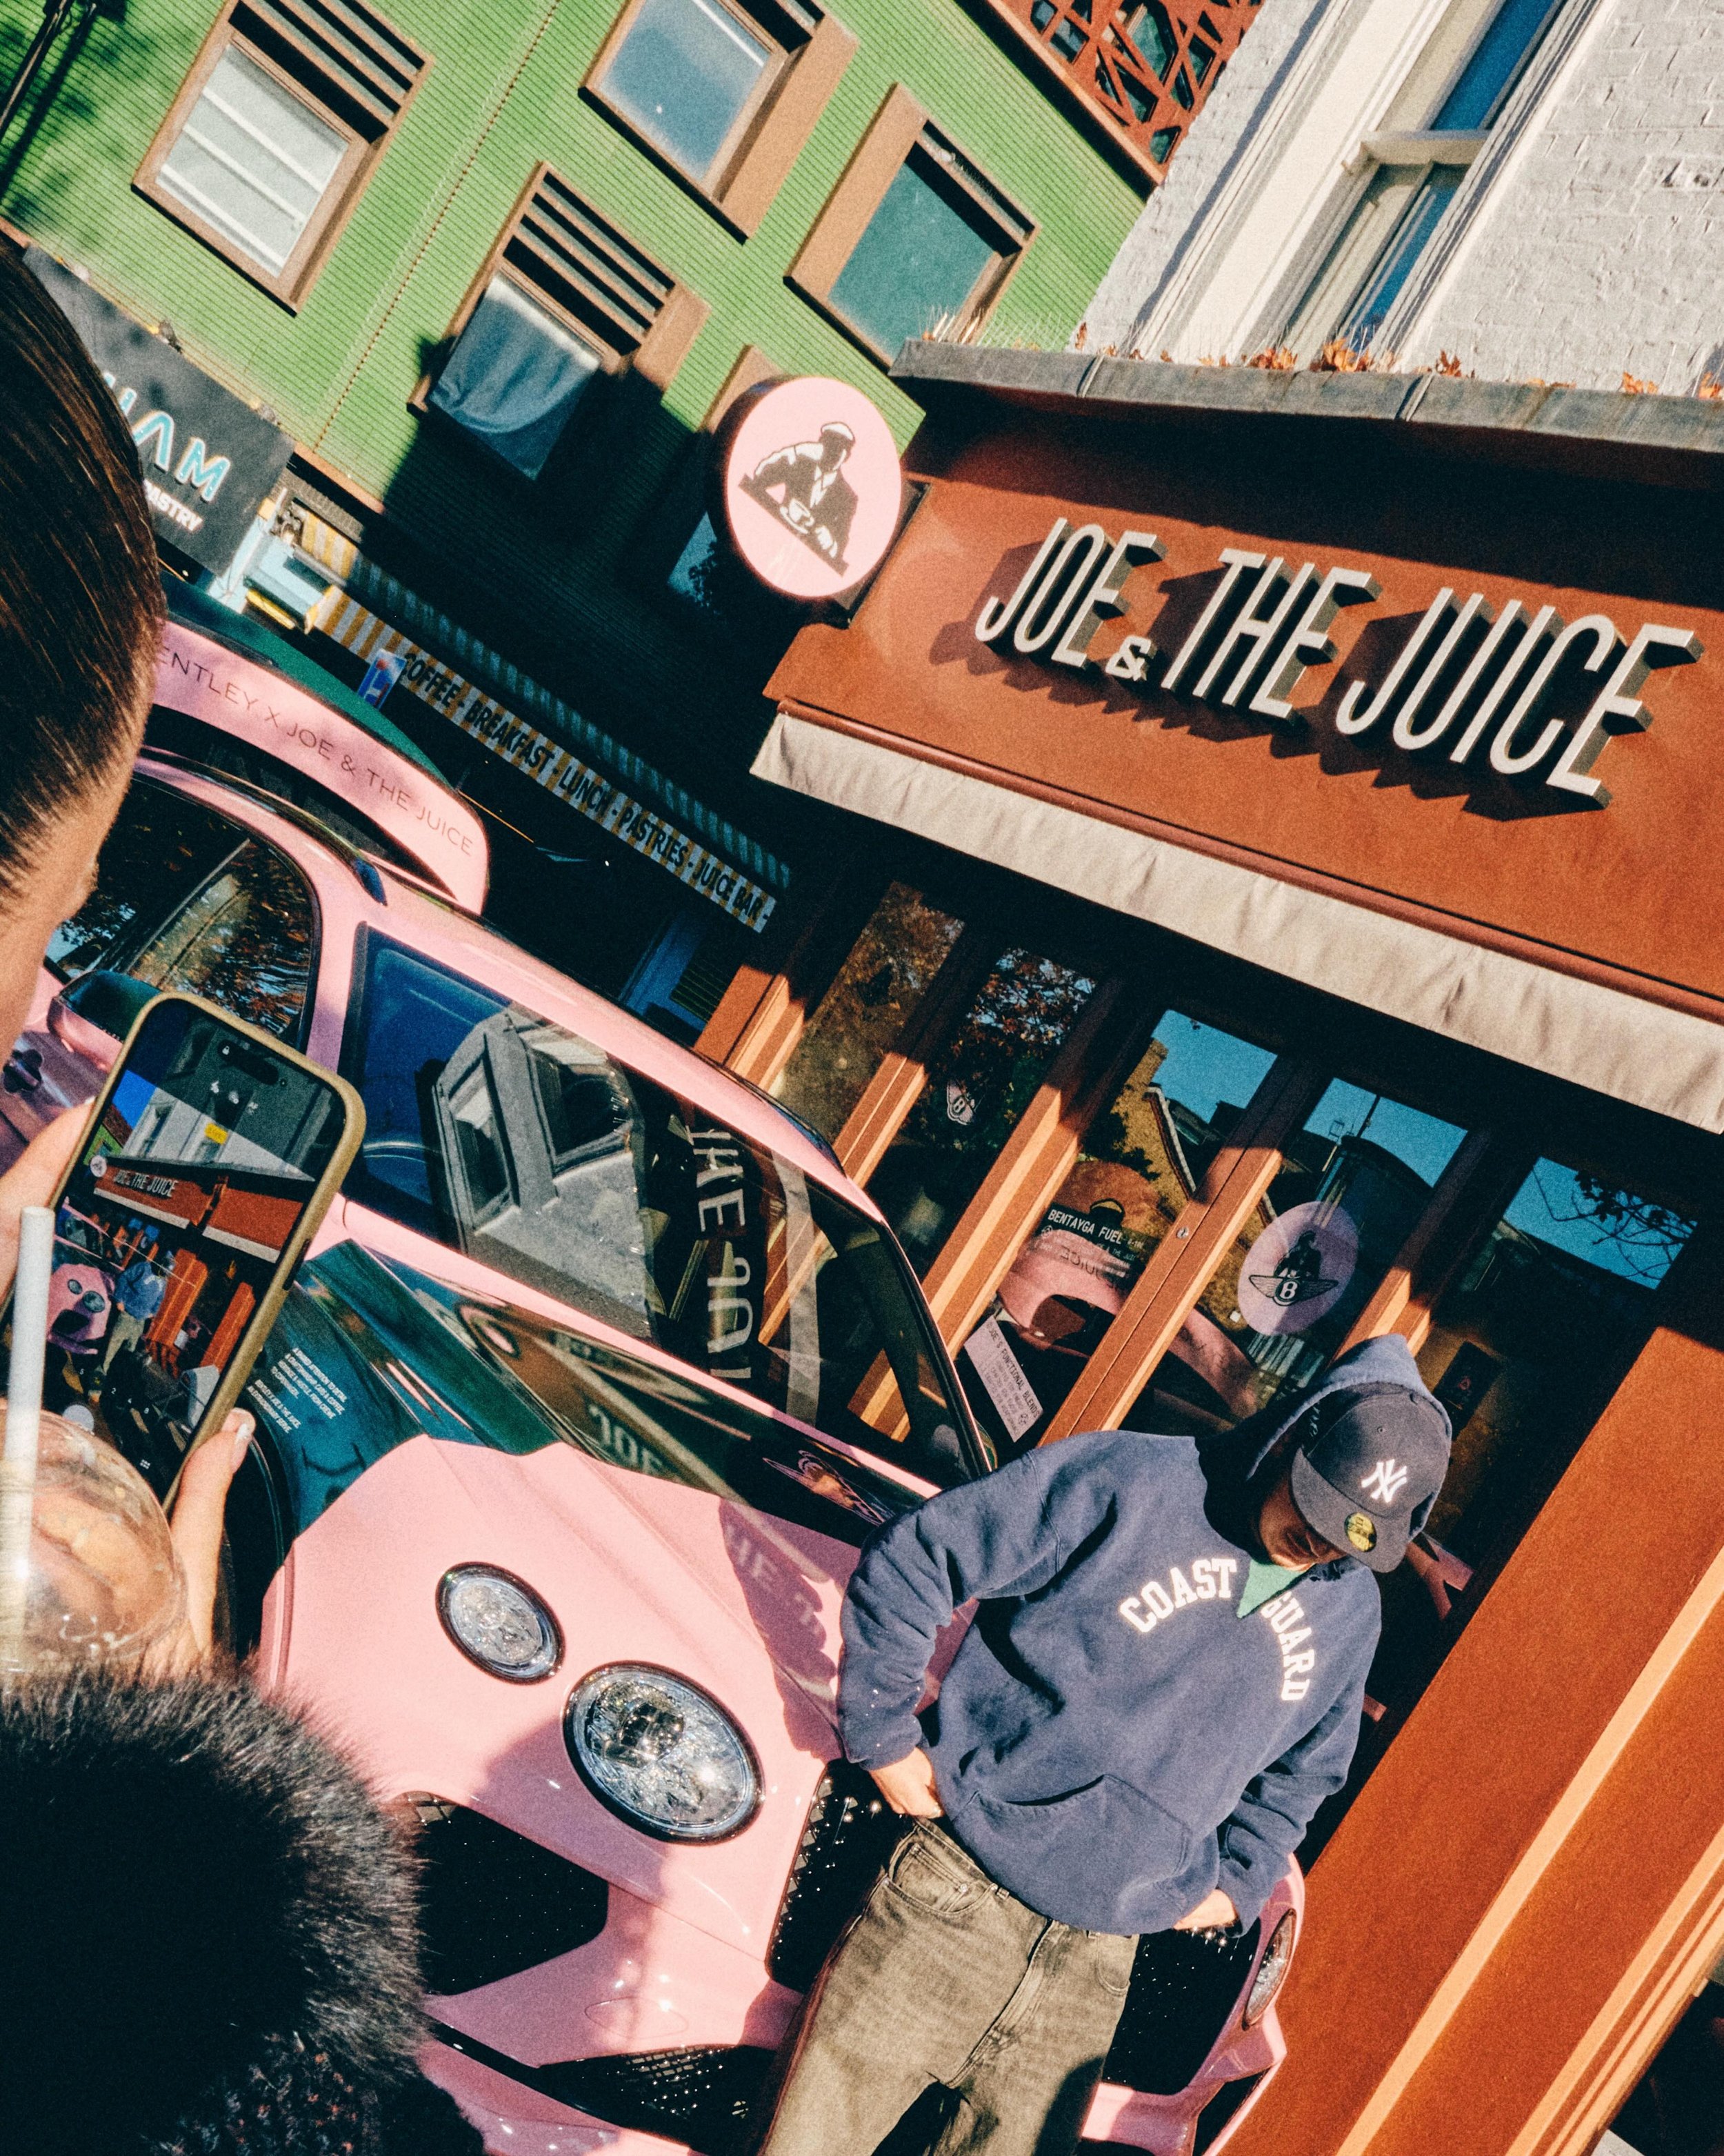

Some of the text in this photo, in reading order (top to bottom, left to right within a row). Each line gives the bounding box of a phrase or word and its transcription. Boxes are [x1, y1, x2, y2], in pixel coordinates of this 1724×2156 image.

[974, 517, 1696, 797] JOE & THE JUICE
[158, 646, 259, 710] ENTLEY
[286, 722, 334, 760] JOE
[340, 754, 356, 777] &
[367, 768, 412, 812] THE
[415, 806, 474, 857] JUICE
[401, 652, 461, 708] COFFEE
[464, 699, 555, 773] BREAKFAST
[558, 765, 614, 817] LUNCH
[618, 806, 689, 868] PASTRIES
[692, 857, 737, 901] JUICE
[732, 885, 765, 922] BAR
[147, 1175, 179, 1197] JUICE
[1048, 1208, 1096, 1235] BENTAYGA
[1098, 1226, 1123, 1244] FUEL
[1021, 1390, 1041, 1419] BLENDS
[1119, 1557, 1316, 1701] COAST GUARD
